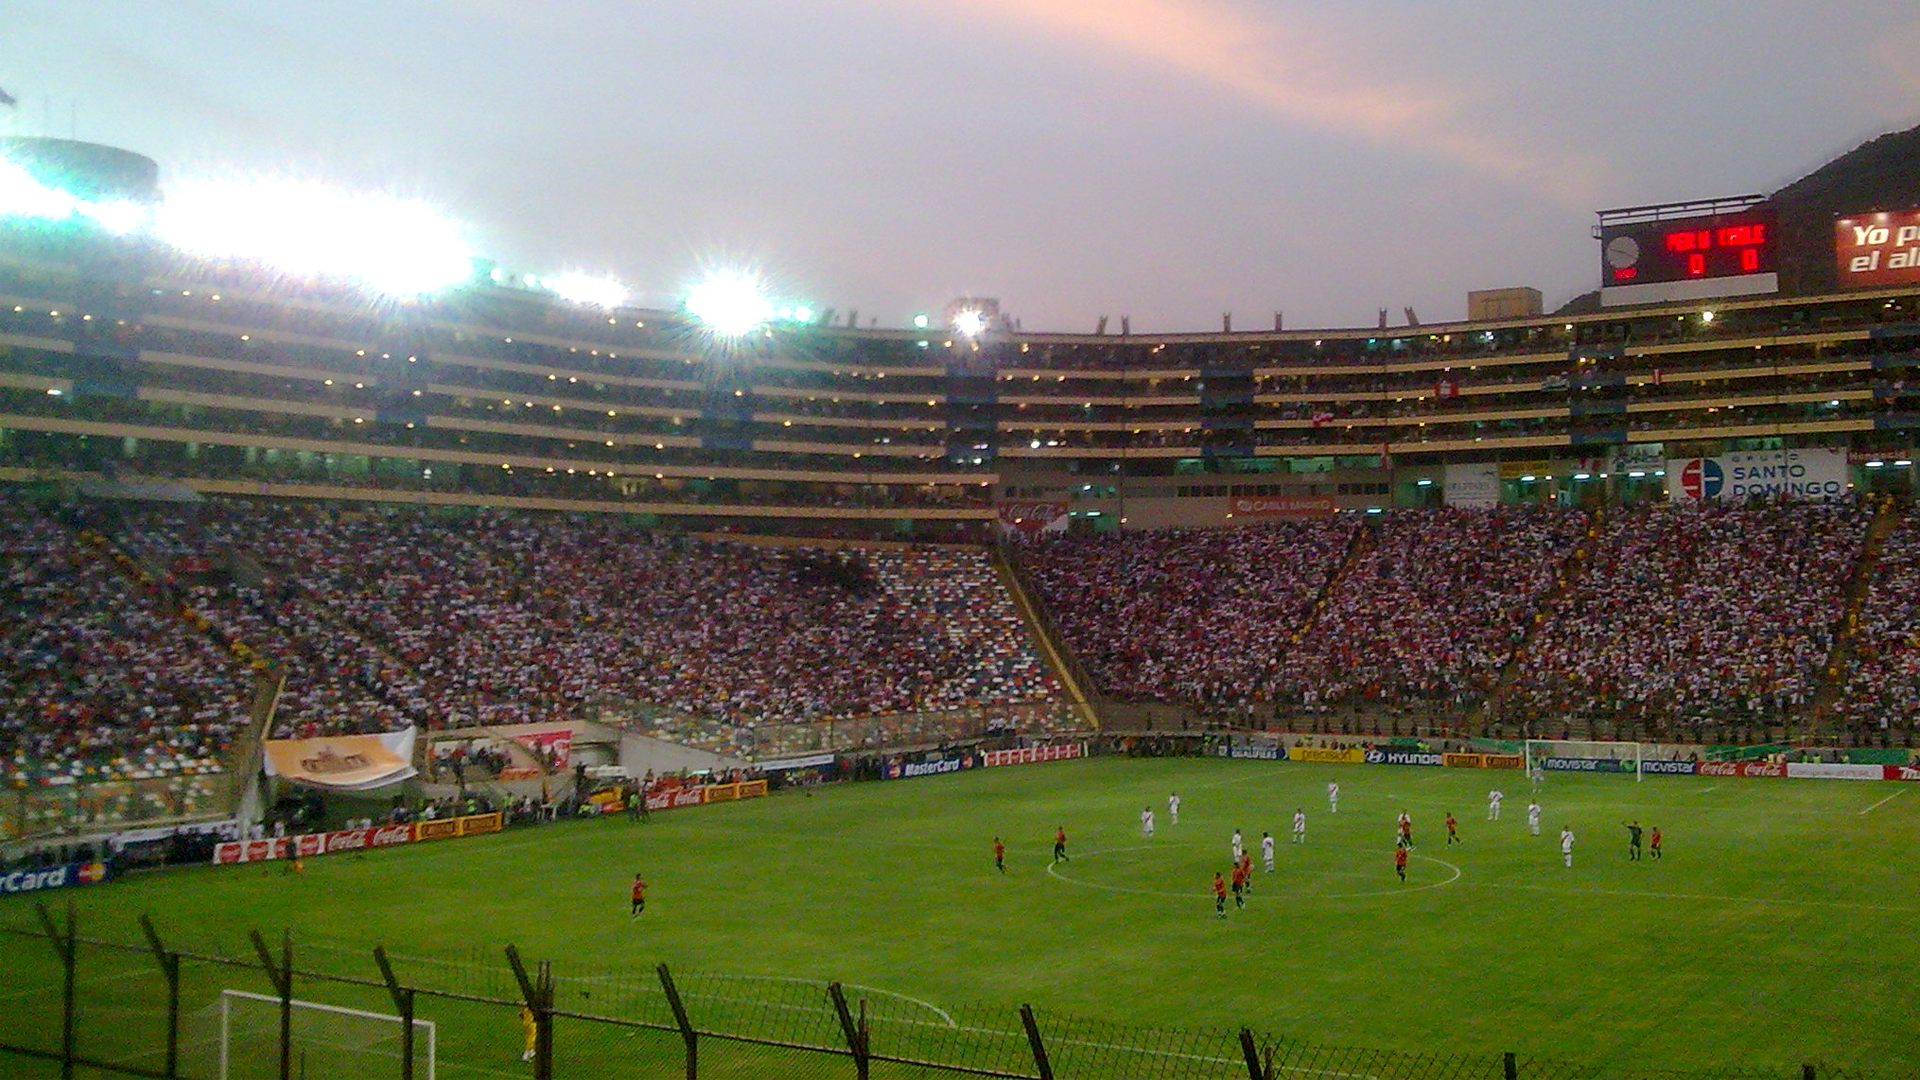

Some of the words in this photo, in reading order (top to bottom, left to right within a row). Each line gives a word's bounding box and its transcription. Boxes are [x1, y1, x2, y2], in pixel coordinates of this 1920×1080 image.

[1853, 225, 1889, 246] Yo
[1896, 226, 1920, 247] p
[1689, 254, 1704, 275] 0
[1743, 249, 1758, 271] 0
[1850, 250, 1880, 272] el
[1732, 453, 1799, 463] GRUPO
[1733, 464, 1806, 480] SANTO
[1732, 481, 1841, 497] DOMINGO
[904, 758, 960, 777] MasterCard
[1547, 758, 1598, 770] movistar
[1642, 761, 1694, 773] movistar
